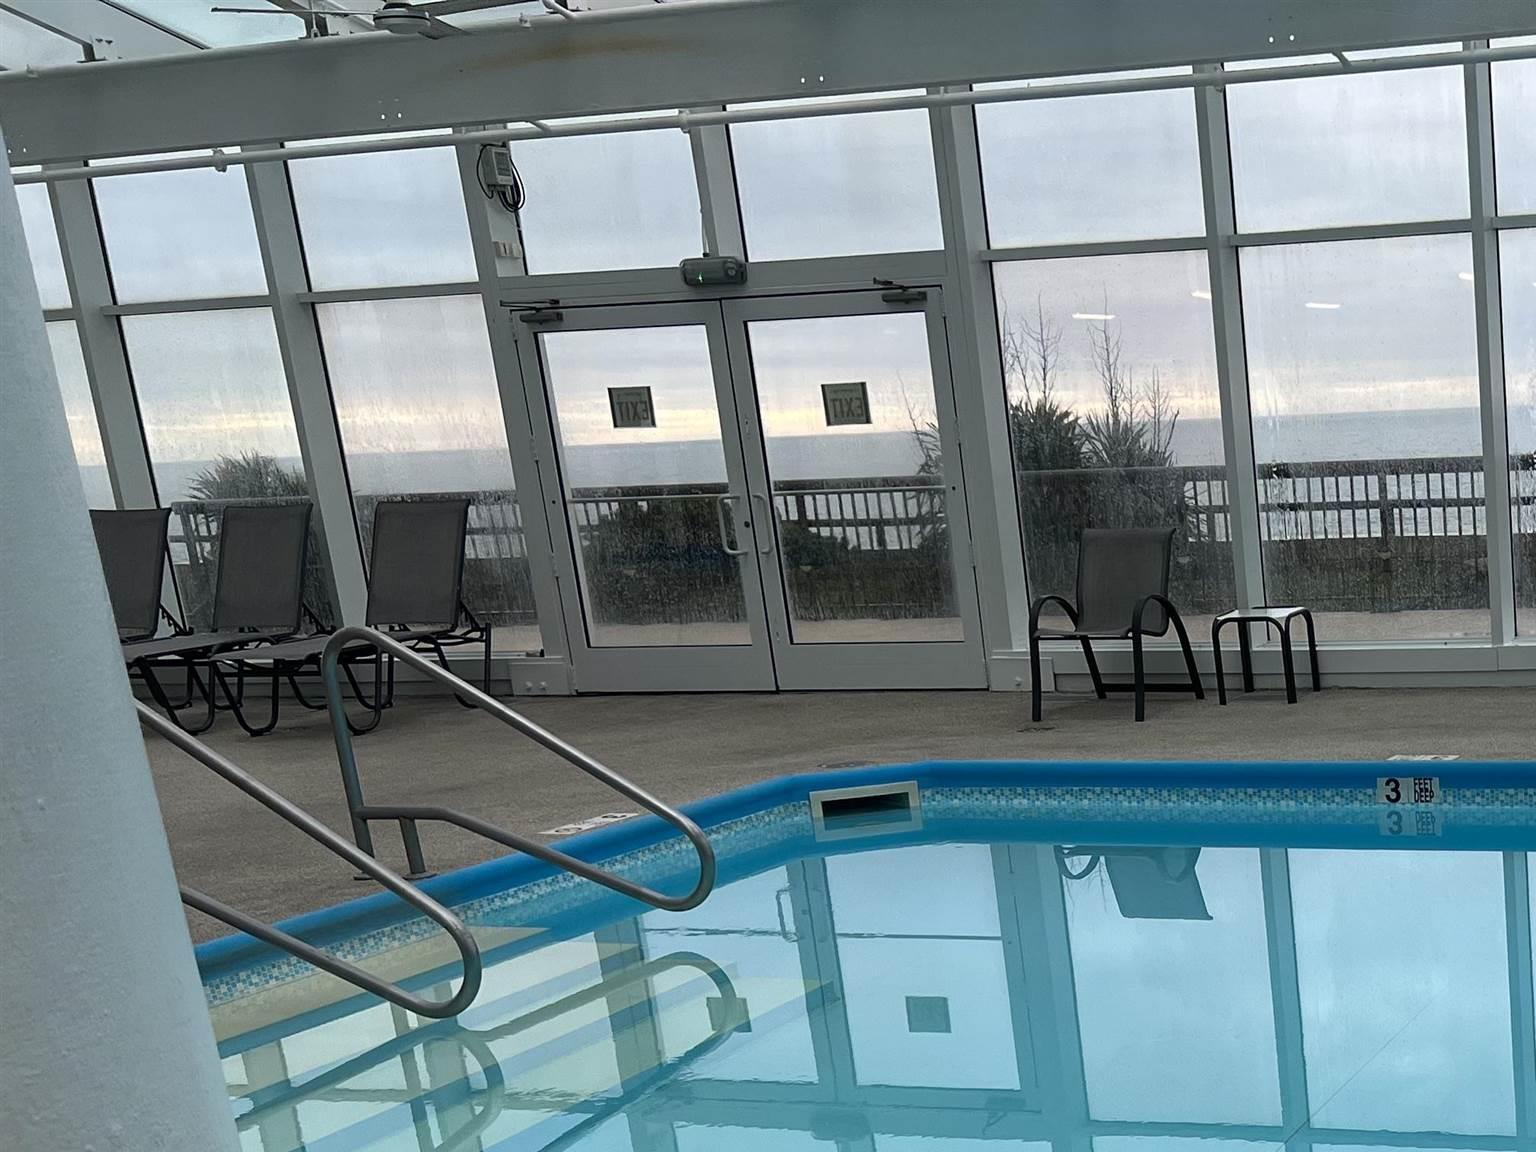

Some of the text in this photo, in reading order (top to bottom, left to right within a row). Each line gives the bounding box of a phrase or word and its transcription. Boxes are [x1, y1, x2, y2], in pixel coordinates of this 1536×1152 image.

[1384, 777, 1402, 804] 3
[1413, 777, 1433, 791] FEET
[1413, 790, 1435, 803] DEEP
